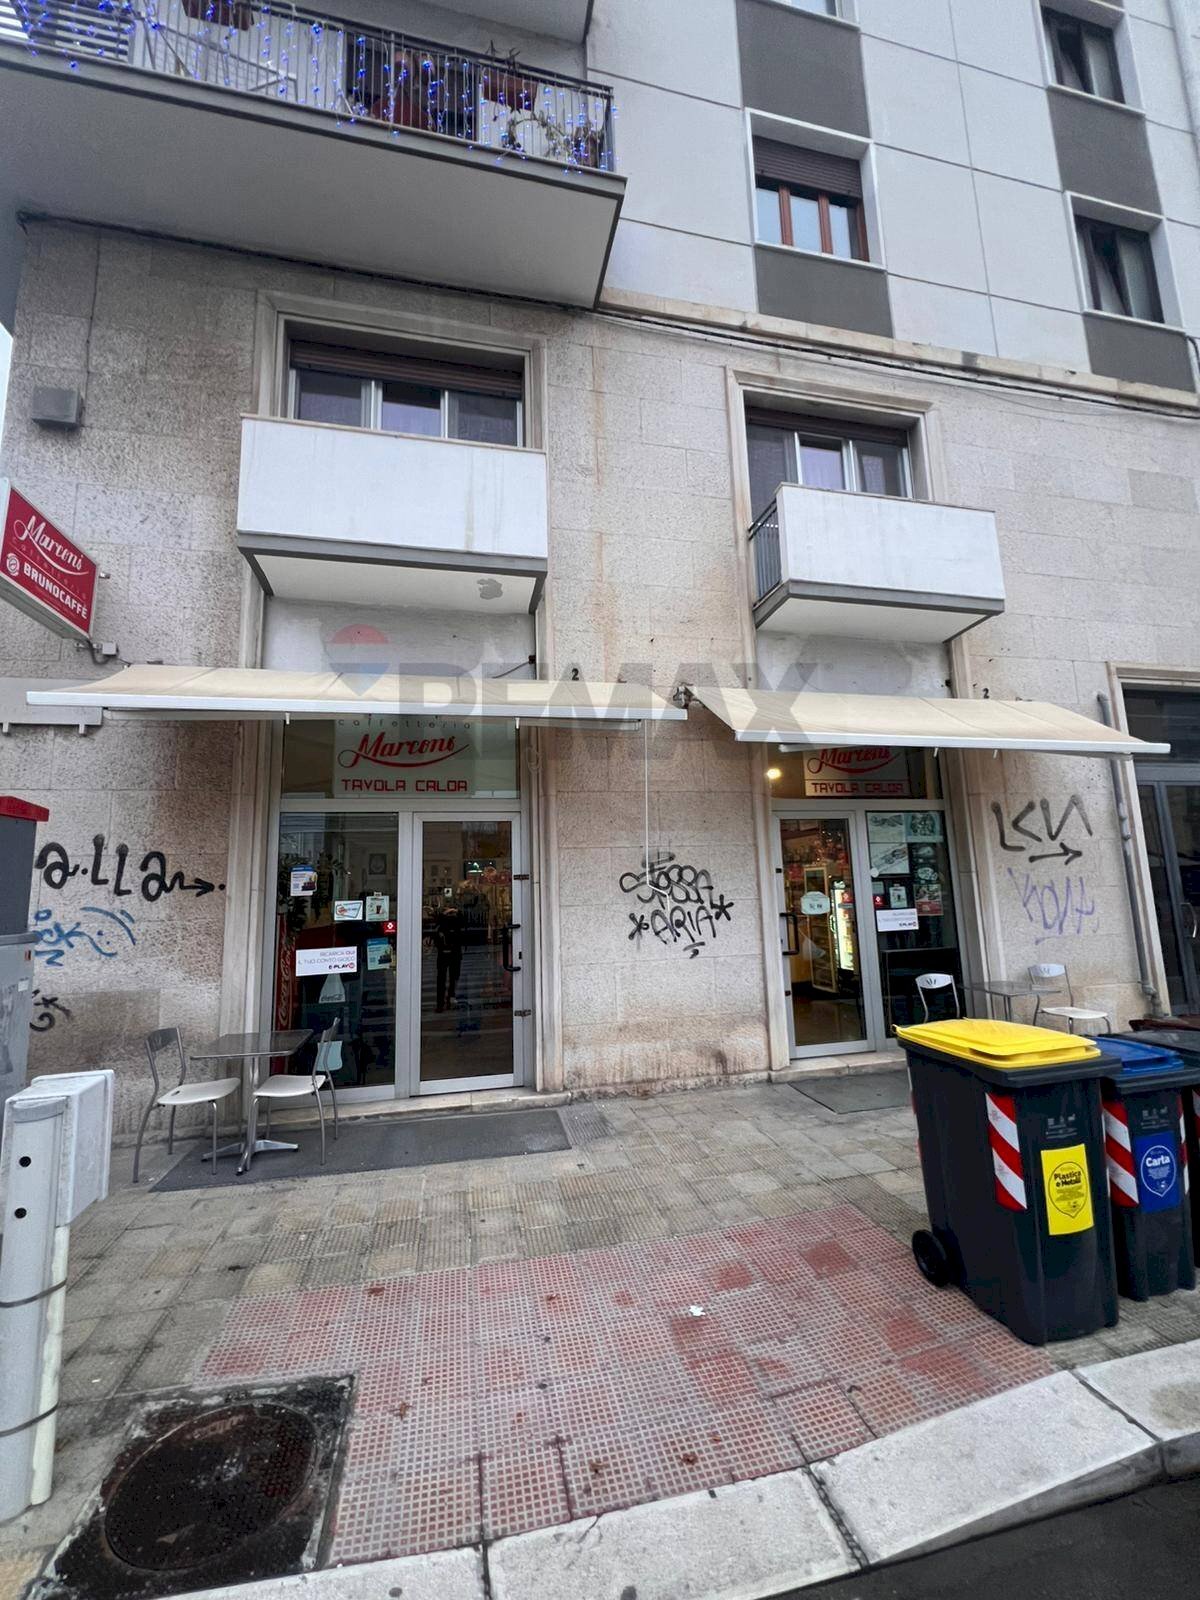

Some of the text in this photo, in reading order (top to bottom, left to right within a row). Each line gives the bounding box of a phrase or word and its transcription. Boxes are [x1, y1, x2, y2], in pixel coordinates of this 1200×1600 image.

[14, 515, 89, 575] Marconi
[571, 667, 580, 681] 2
[983, 687, 990, 699] 2
[337, 731, 470, 768] Marconi
[341, 779, 406, 792] TAVOLA
[811, 782, 859, 793] TAVOLA
[1146, 1155, 1170, 1167] Carta
[1054, 1170, 1082, 1181] Plastica
